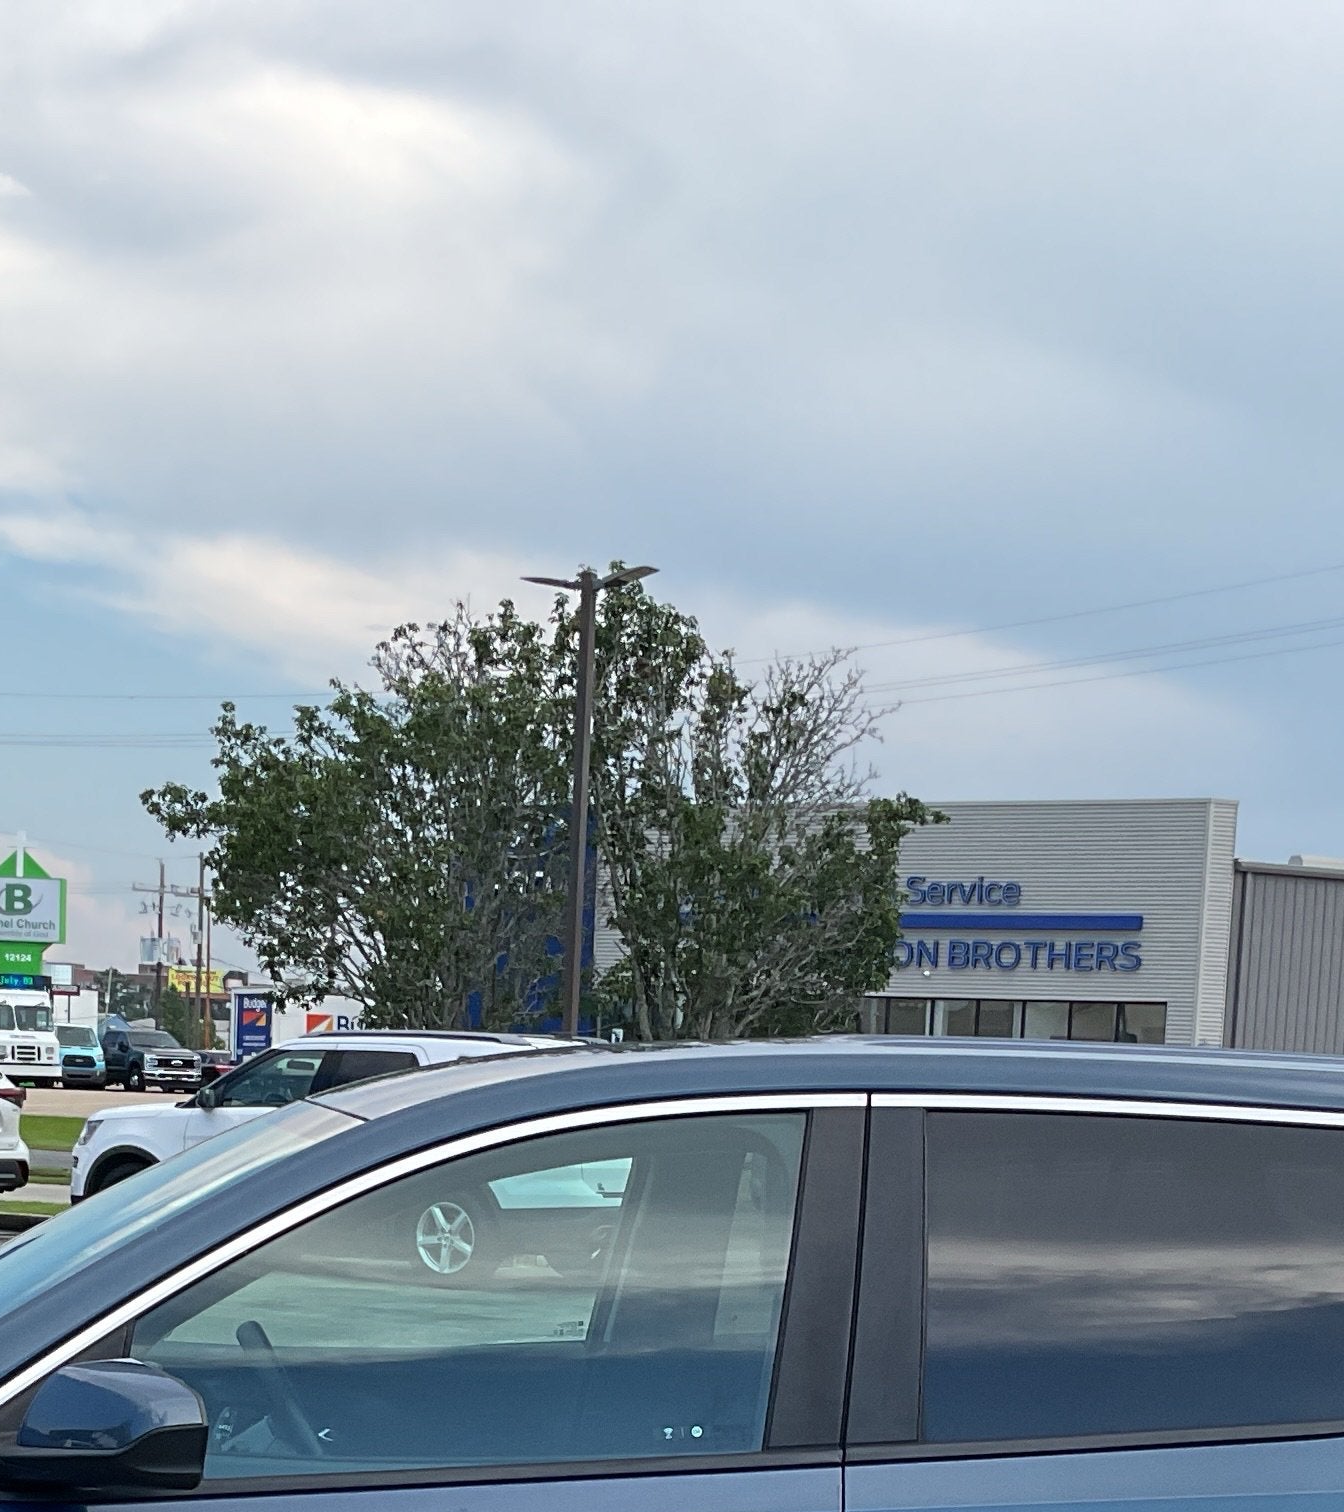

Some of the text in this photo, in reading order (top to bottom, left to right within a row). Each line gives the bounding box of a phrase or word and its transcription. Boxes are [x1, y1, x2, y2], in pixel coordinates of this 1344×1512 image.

[906, 876, 1022, 906] Service
[16, 918, 56, 930] Church
[4, 953, 32, 962] 12124
[947, 940, 1142, 972] BROTHERS
